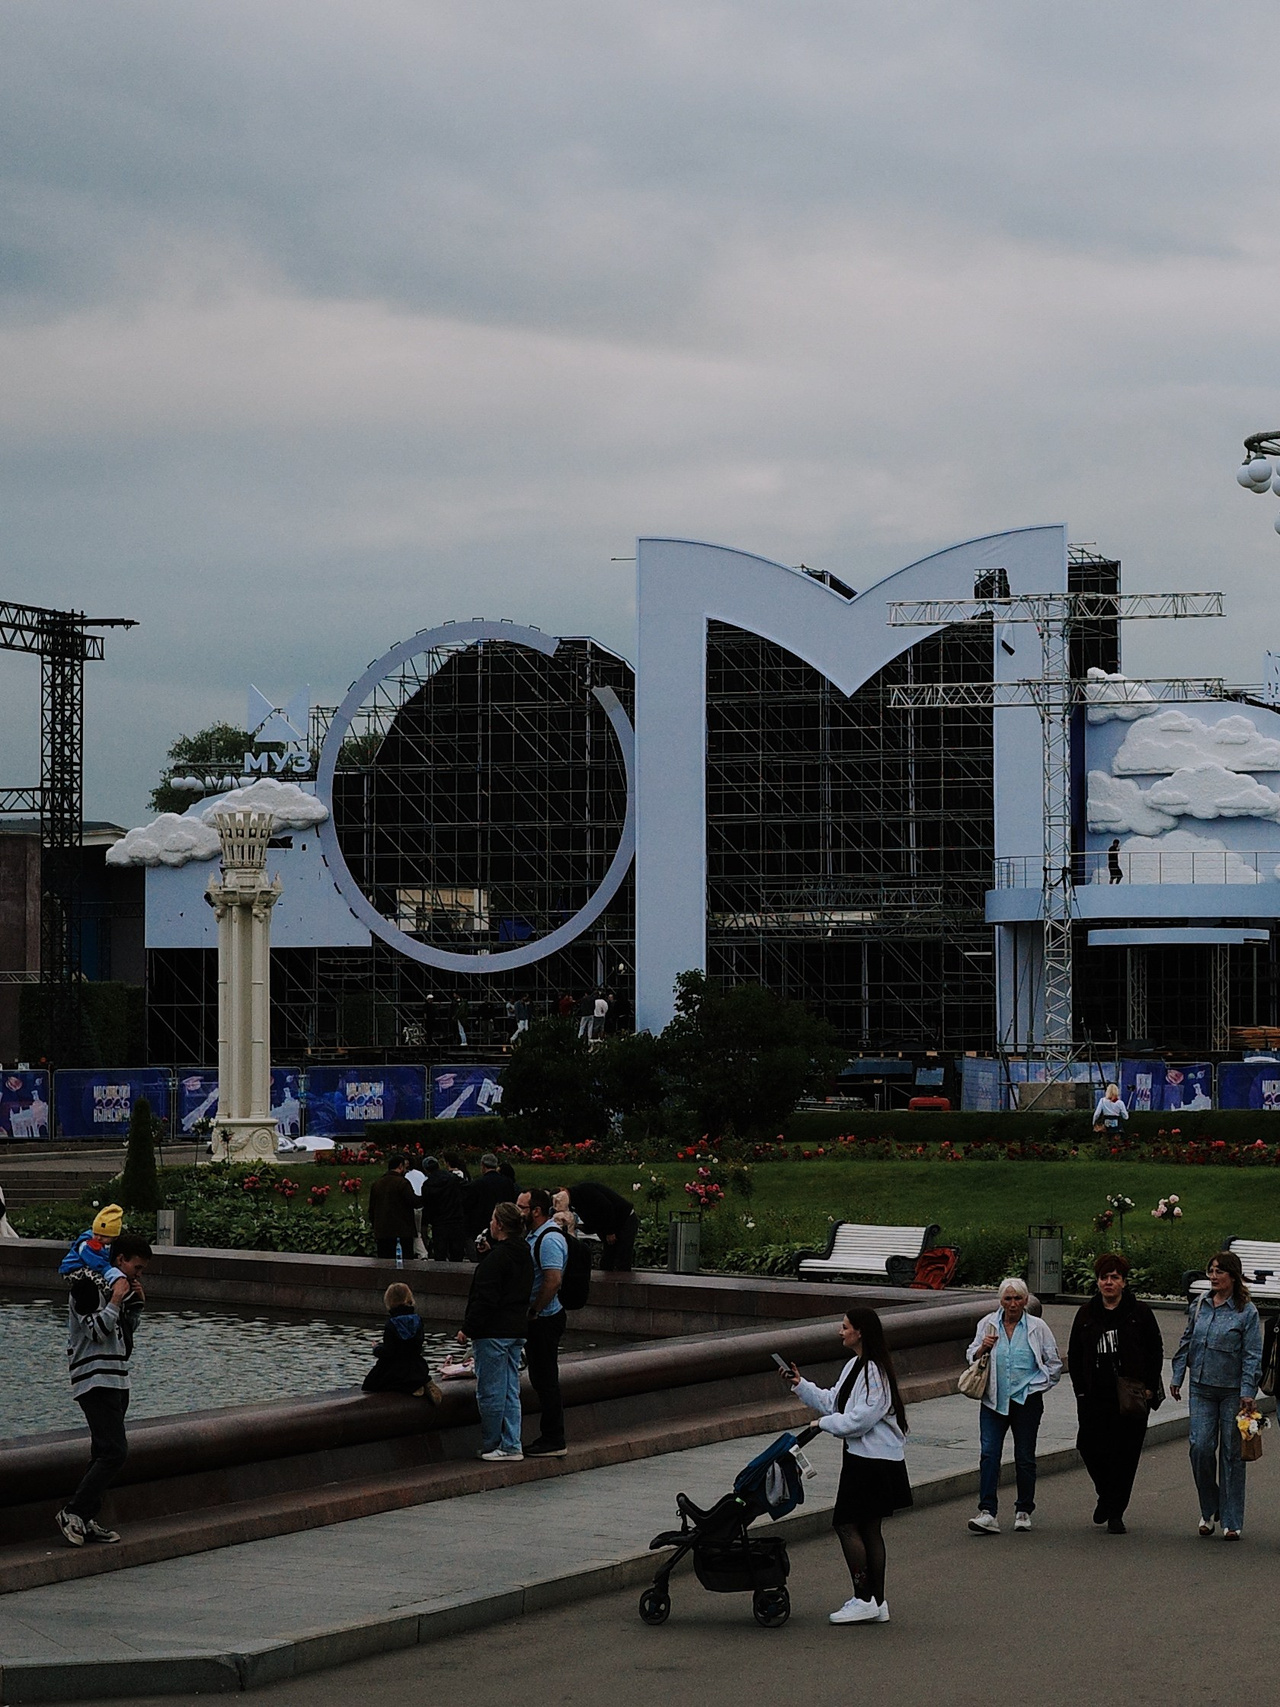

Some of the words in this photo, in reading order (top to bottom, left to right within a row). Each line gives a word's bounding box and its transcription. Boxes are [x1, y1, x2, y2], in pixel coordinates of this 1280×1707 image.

[243, 751, 312, 774] МУЗ
[95, 1096, 131, 1109] 2026
[347, 1094, 383, 1107] 2026
